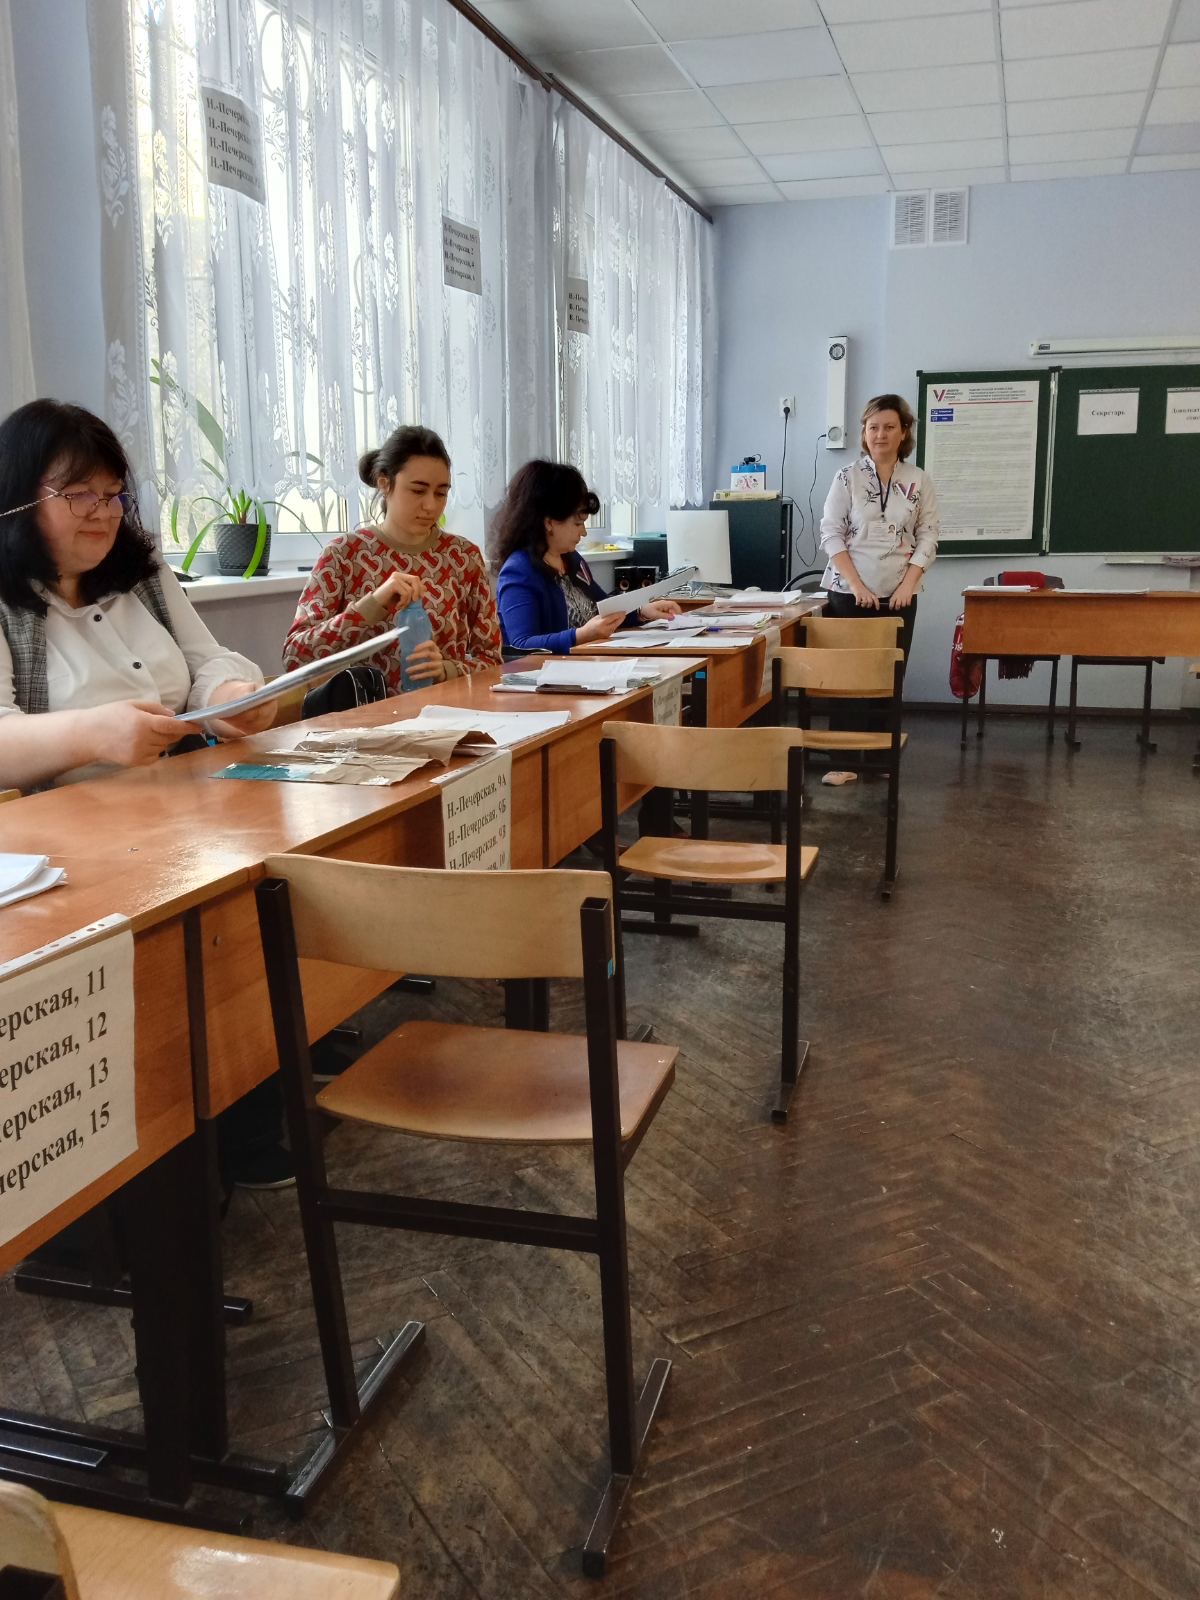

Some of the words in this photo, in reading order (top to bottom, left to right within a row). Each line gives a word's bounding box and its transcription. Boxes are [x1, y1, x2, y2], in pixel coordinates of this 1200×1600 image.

[447, 782, 497, 819] Н.-Печерская,
[448, 810, 498, 848] Н.-Печерская,
[87, 965, 107, 997] 11
[0, 1034, 80, 1092] ерская,
[86, 1011, 108, 1043] 12
[0, 1081, 82, 1142] ерская,
[88, 1056, 109, 1090] 13
[89, 1100, 110, 1136] 15
